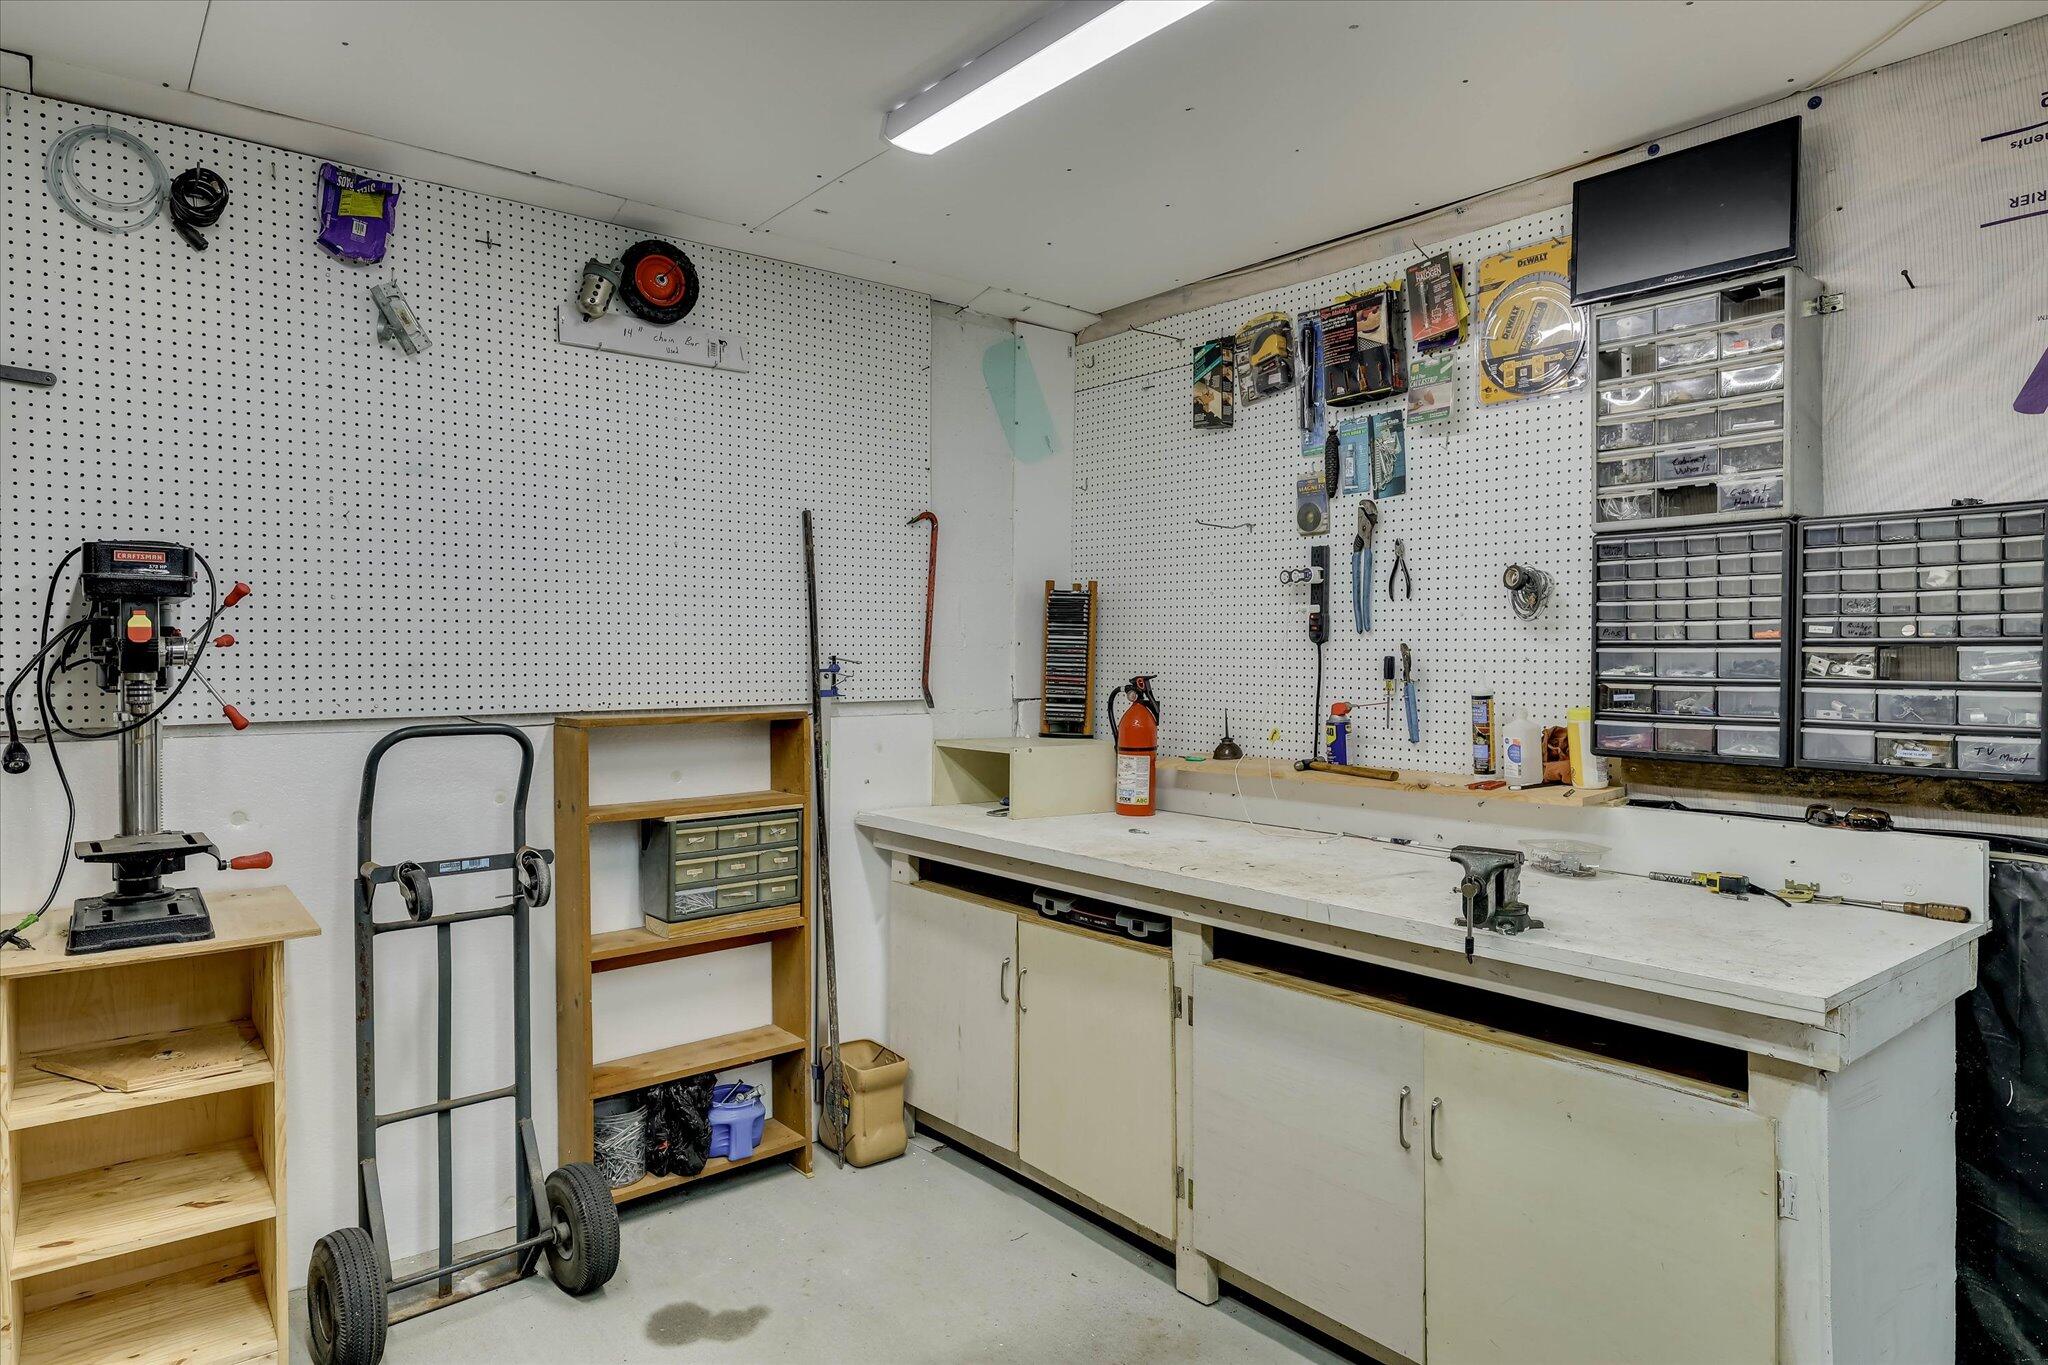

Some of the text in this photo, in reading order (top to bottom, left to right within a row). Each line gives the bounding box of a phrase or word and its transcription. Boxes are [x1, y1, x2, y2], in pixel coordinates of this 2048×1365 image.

[2010, 132, 2048, 149] ents
[1517, 252, 1548, 268] DEWALT
[117, 552, 163, 560] CRAFTSMAN
